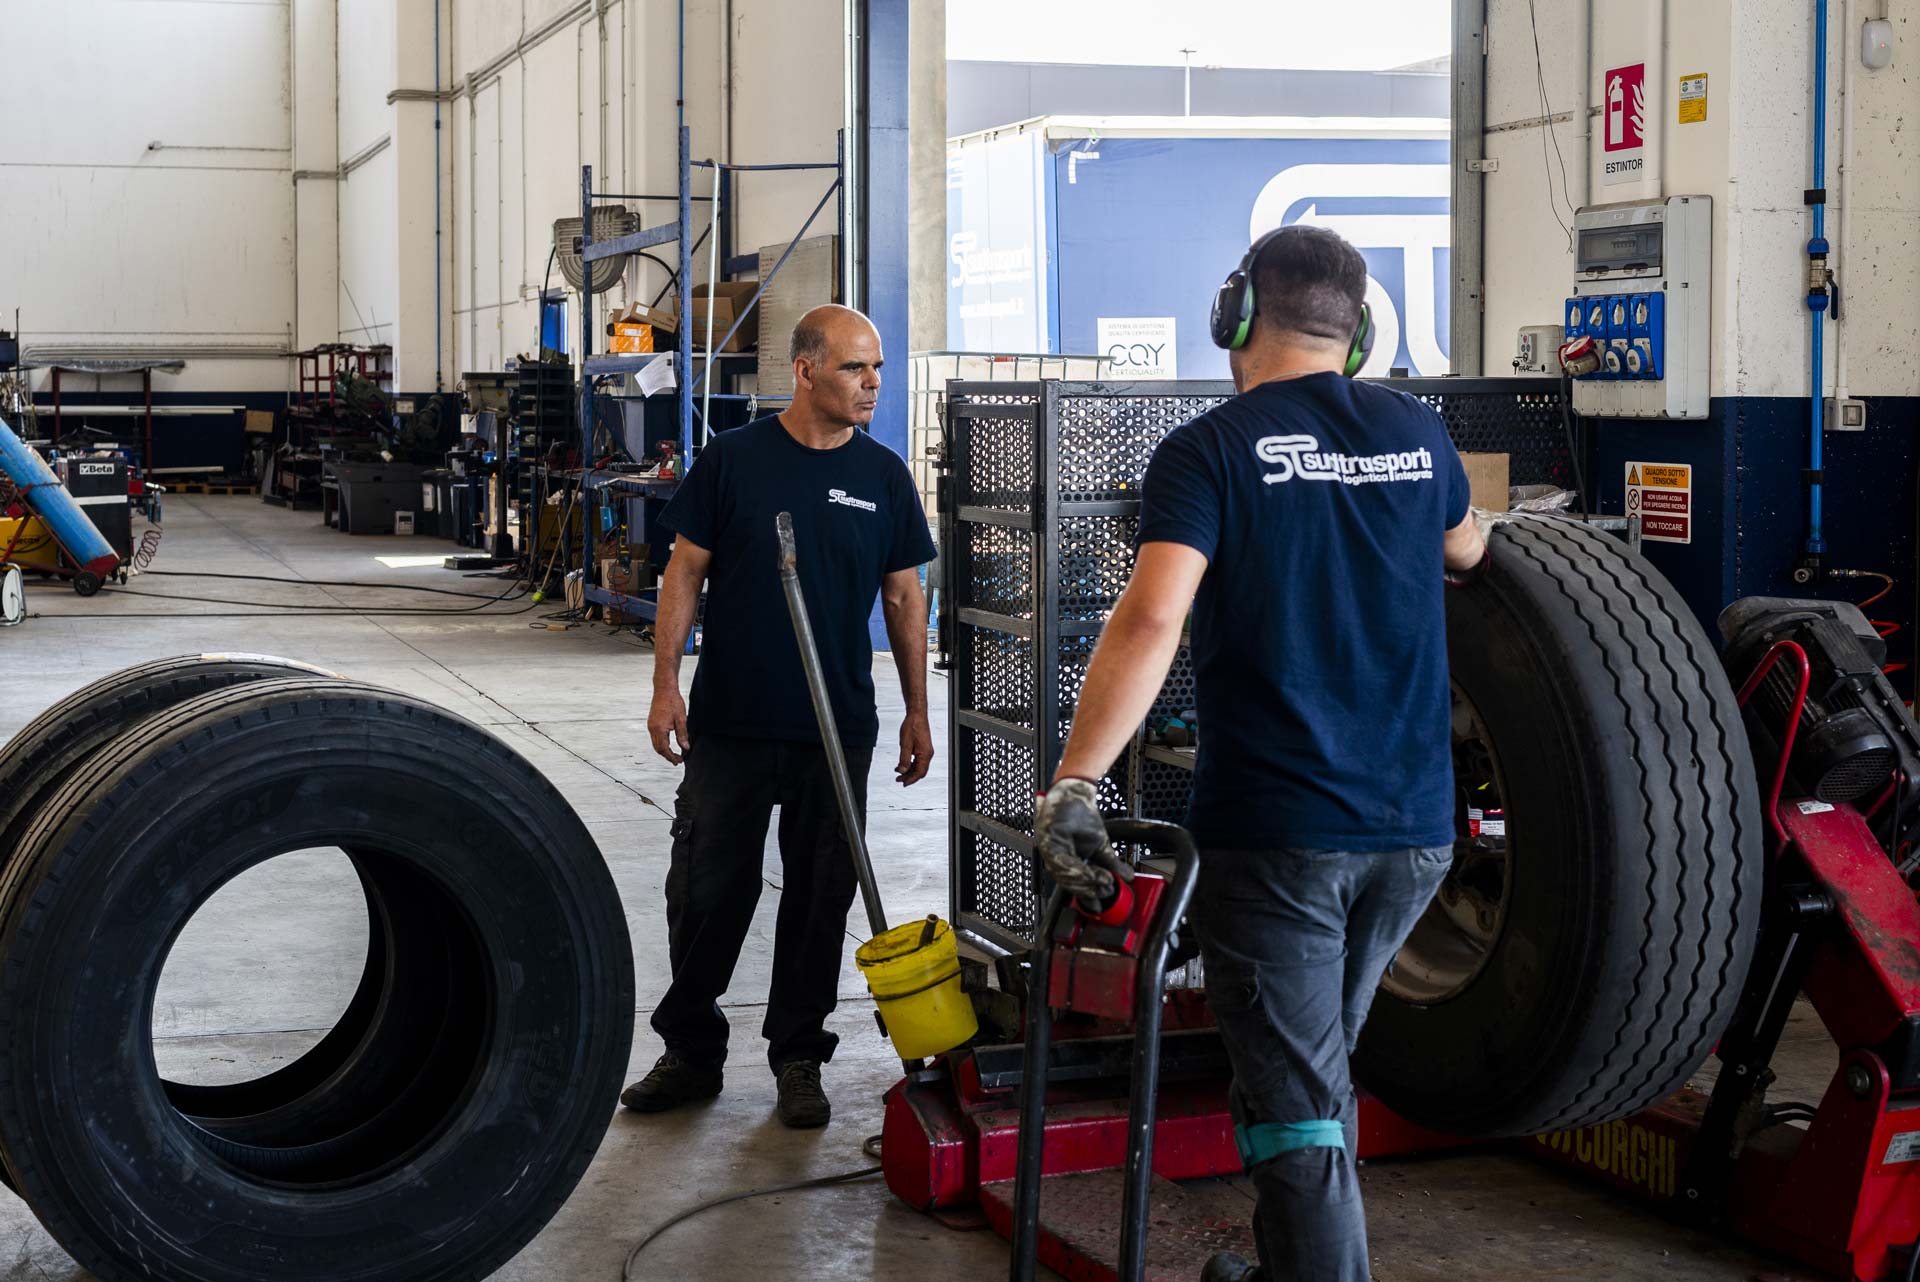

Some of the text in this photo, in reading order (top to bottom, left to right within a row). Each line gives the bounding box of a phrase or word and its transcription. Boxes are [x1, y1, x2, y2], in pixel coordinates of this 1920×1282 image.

[1605, 158, 1643, 174] ESTINTOR
[1109, 343, 1165, 367] CQY
[90, 465, 113, 473] Beta
[1645, 468, 1686, 478] QUADRO SOTTO
[1343, 470, 1433, 486] logistica integrata
[1652, 477, 1678, 485] TENSIONE
[1646, 521, 1683, 531] NON TOCCARE
